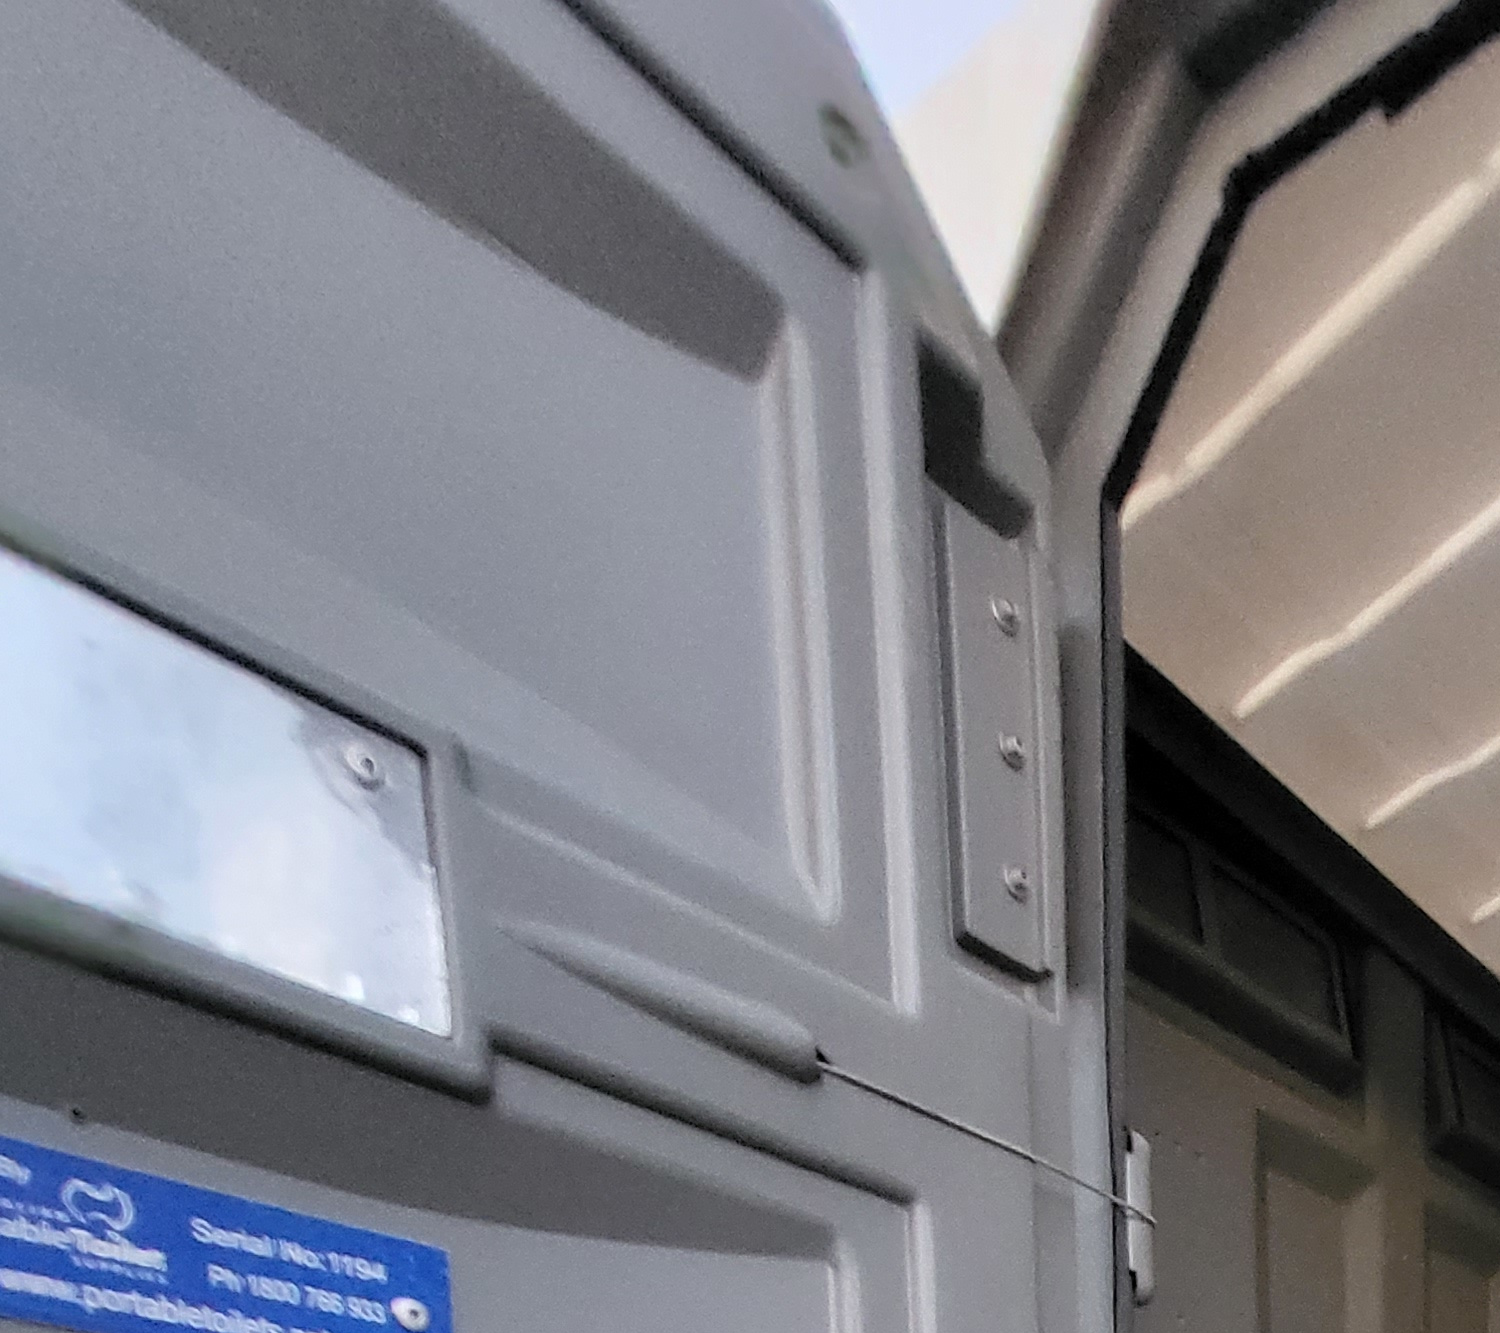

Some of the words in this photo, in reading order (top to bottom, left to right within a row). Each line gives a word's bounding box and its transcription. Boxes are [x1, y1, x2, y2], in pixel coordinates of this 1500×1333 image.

[190, 1217, 274, 1258] Serial
[207, 1262, 243, 1294] Ph
[246, 1273, 300, 1306] 1800
